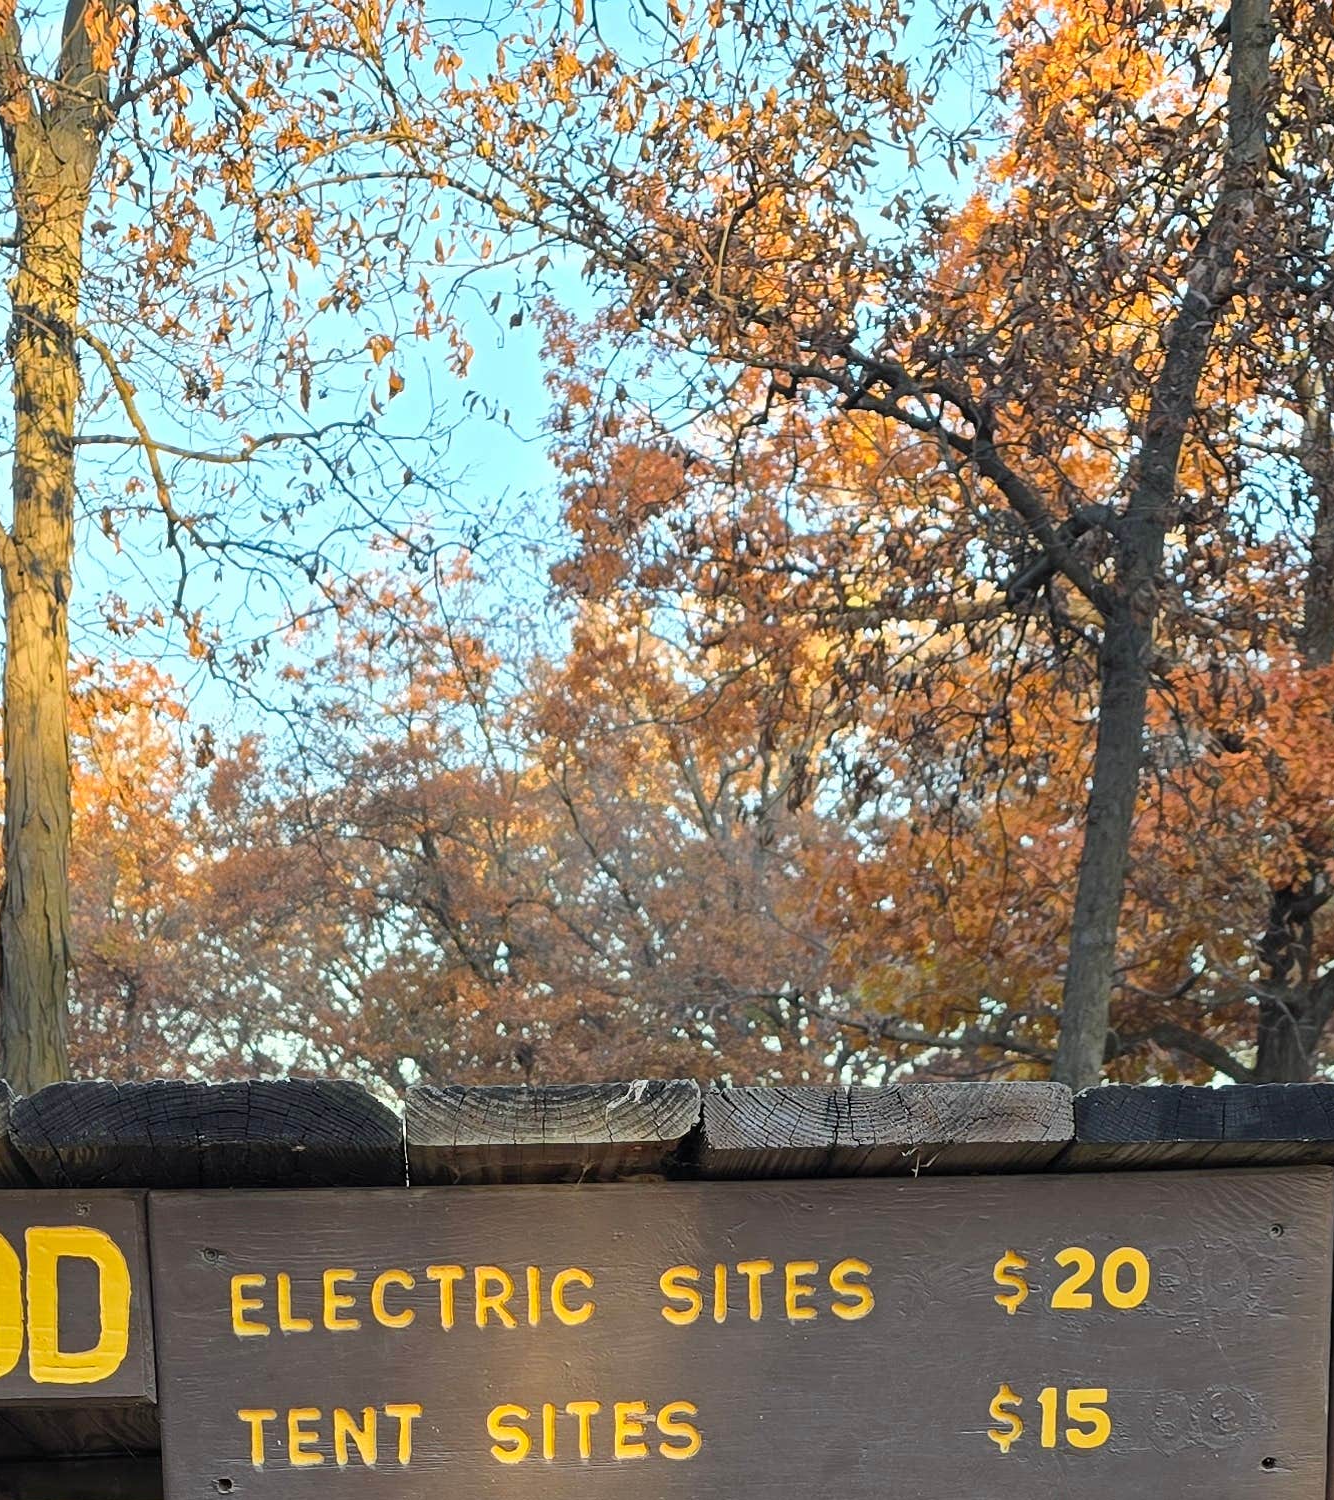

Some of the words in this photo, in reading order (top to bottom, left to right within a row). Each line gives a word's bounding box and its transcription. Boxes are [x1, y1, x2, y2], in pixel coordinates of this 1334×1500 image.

[230, 1264, 597, 1336] ELECTRIC
[659, 1257, 876, 1325] SITES
[238, 1403, 423, 1467] TENT
[485, 1400, 703, 1465] SITES
[987, 1382, 1112, 1453] $15
